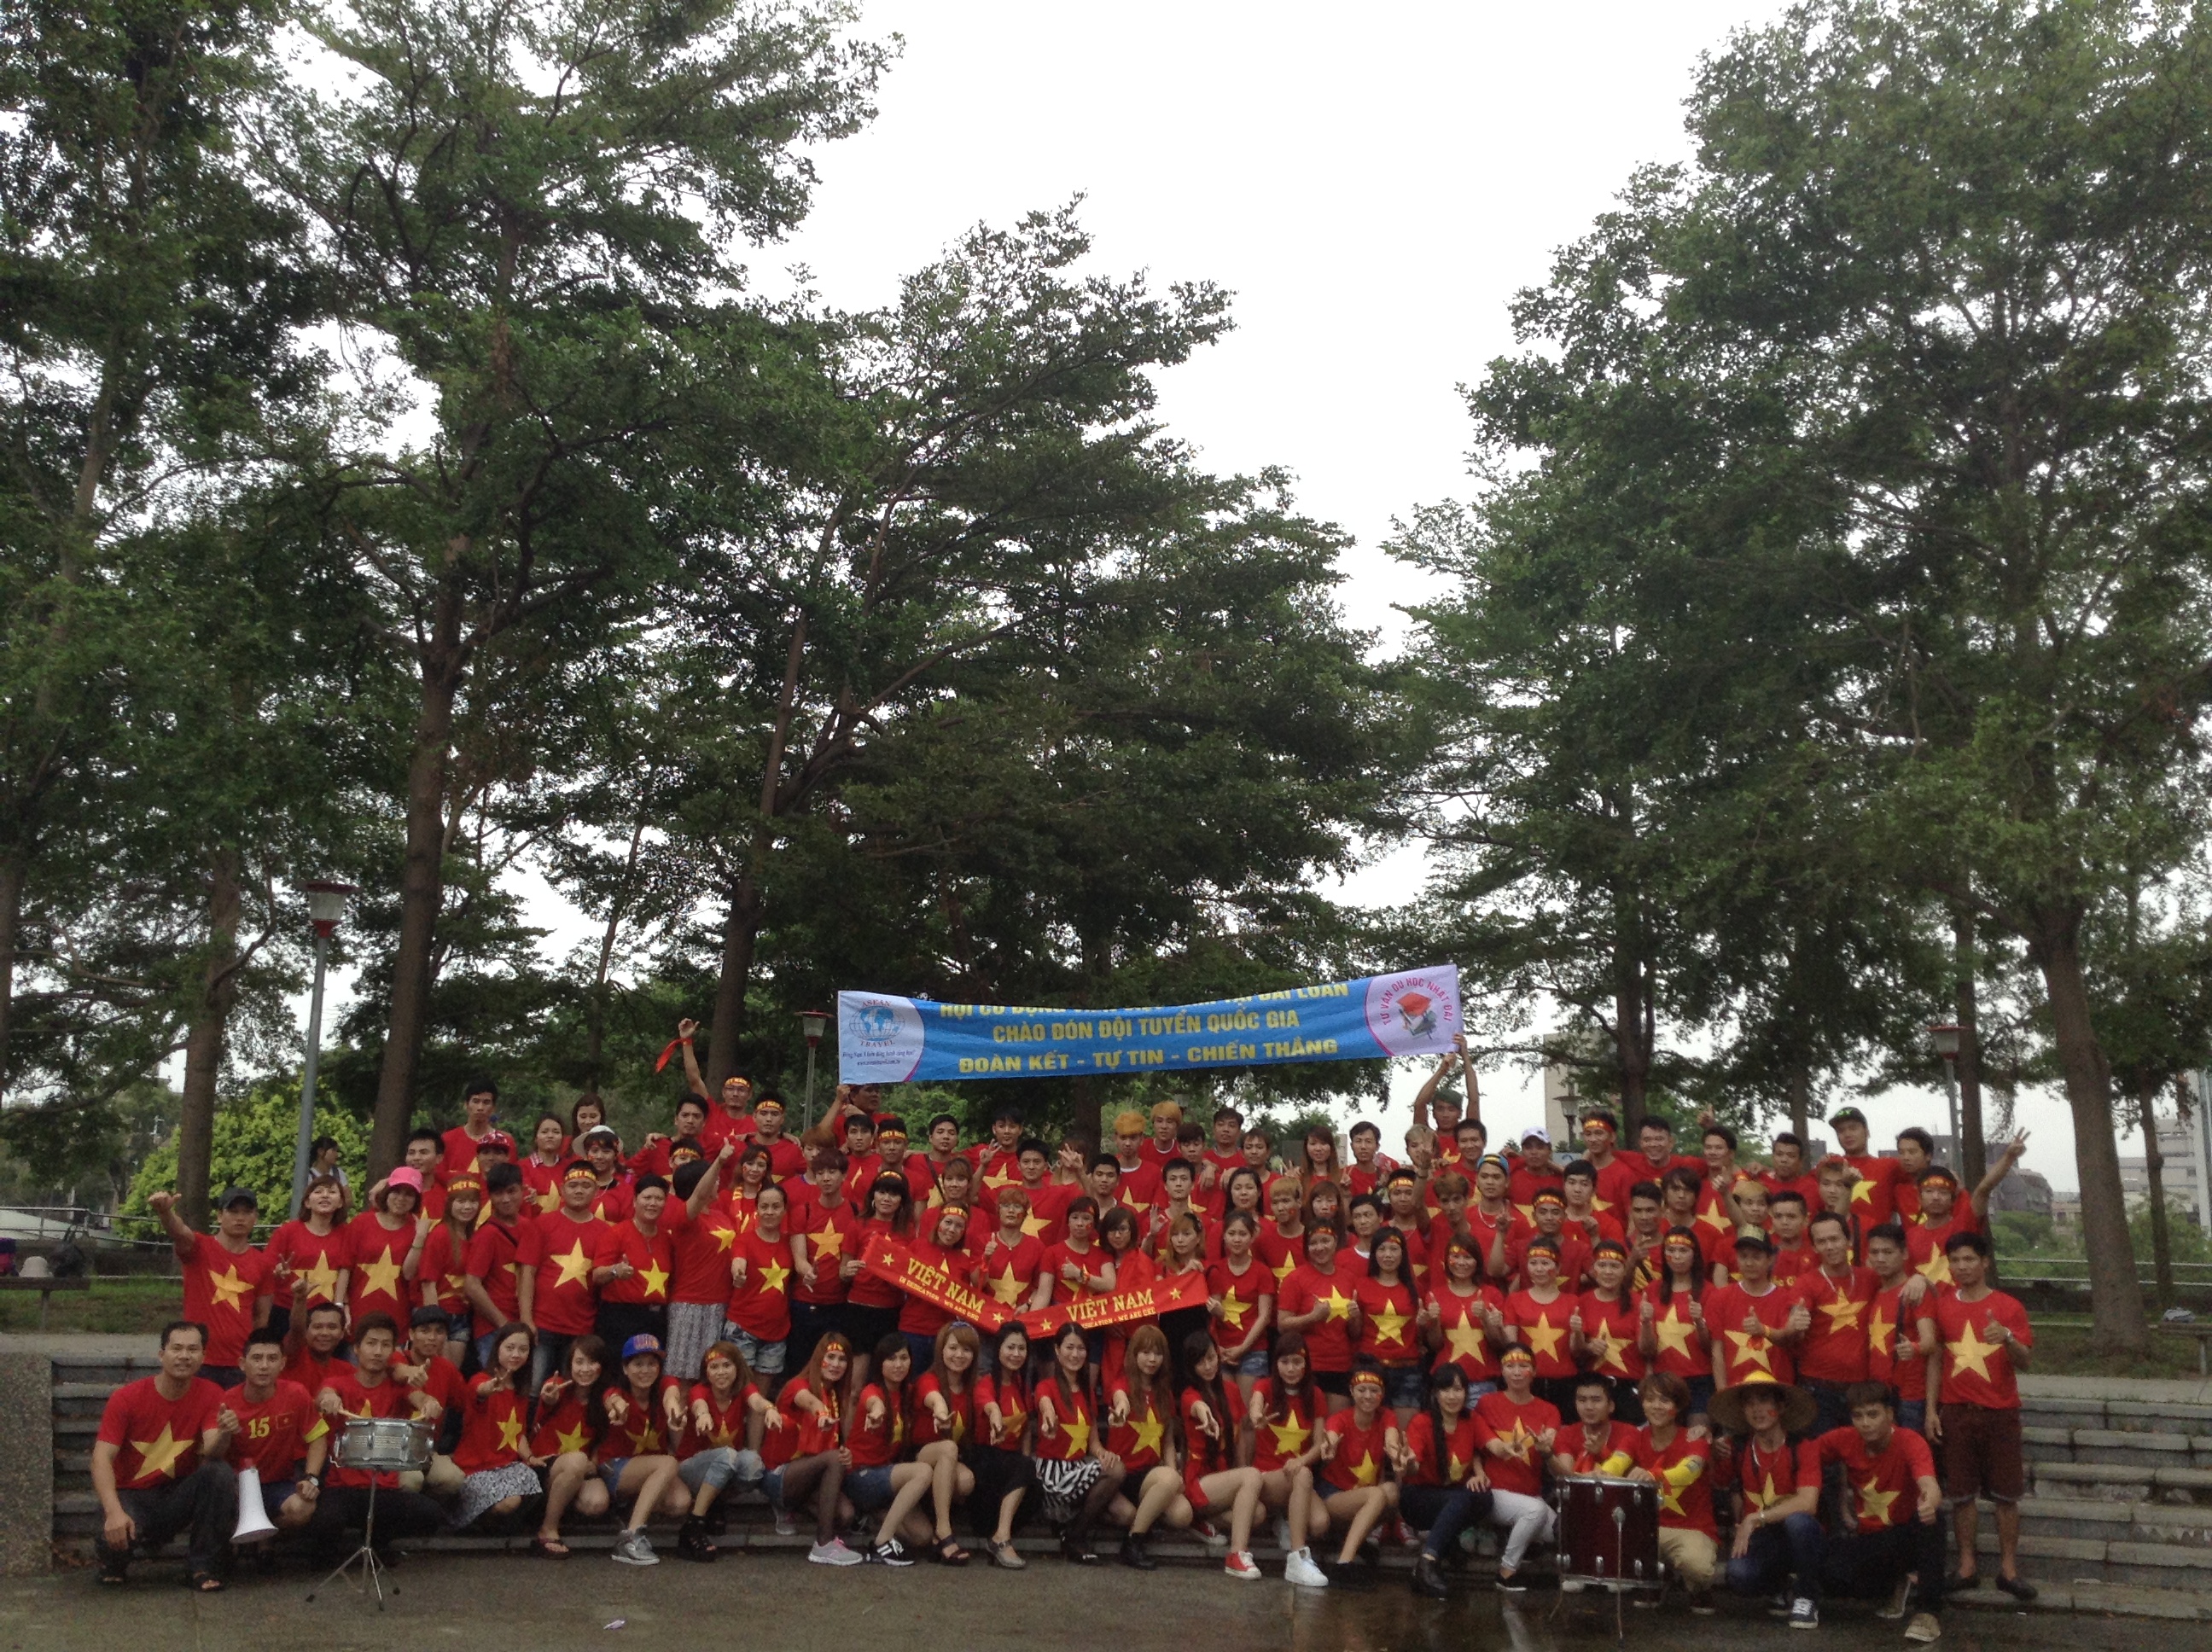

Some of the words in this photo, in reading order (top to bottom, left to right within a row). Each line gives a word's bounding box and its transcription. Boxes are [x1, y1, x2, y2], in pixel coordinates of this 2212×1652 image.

[992, 1021, 1046, 1043] CHÀO
[1051, 1019, 1093, 1040] ĐÓN
[1098, 1015, 1132, 1041] ĐỘI
[1207, 1003, 1260, 1033] QUỐC
[1266, 1009, 1300, 1029] GIA
[861, 1040, 896, 1048] TRAVEL
[958, 1054, 1022, 1073] ĐOÀN
[1029, 1050, 1069, 1070] KẾT
[1092, 1050, 1122, 1069] TỰ
[1127, 1049, 1164, 1065] TIN
[1187, 1039, 1256, 1062] CHIẾN
[907, 1257, 947, 1291] VIỆT
[945, 1281, 986, 1314] NAM
[1065, 1297, 1108, 1322] VIỆT
[1112, 1288, 1154, 1312] NAM
[248, 1416, 271, 1440] 15
